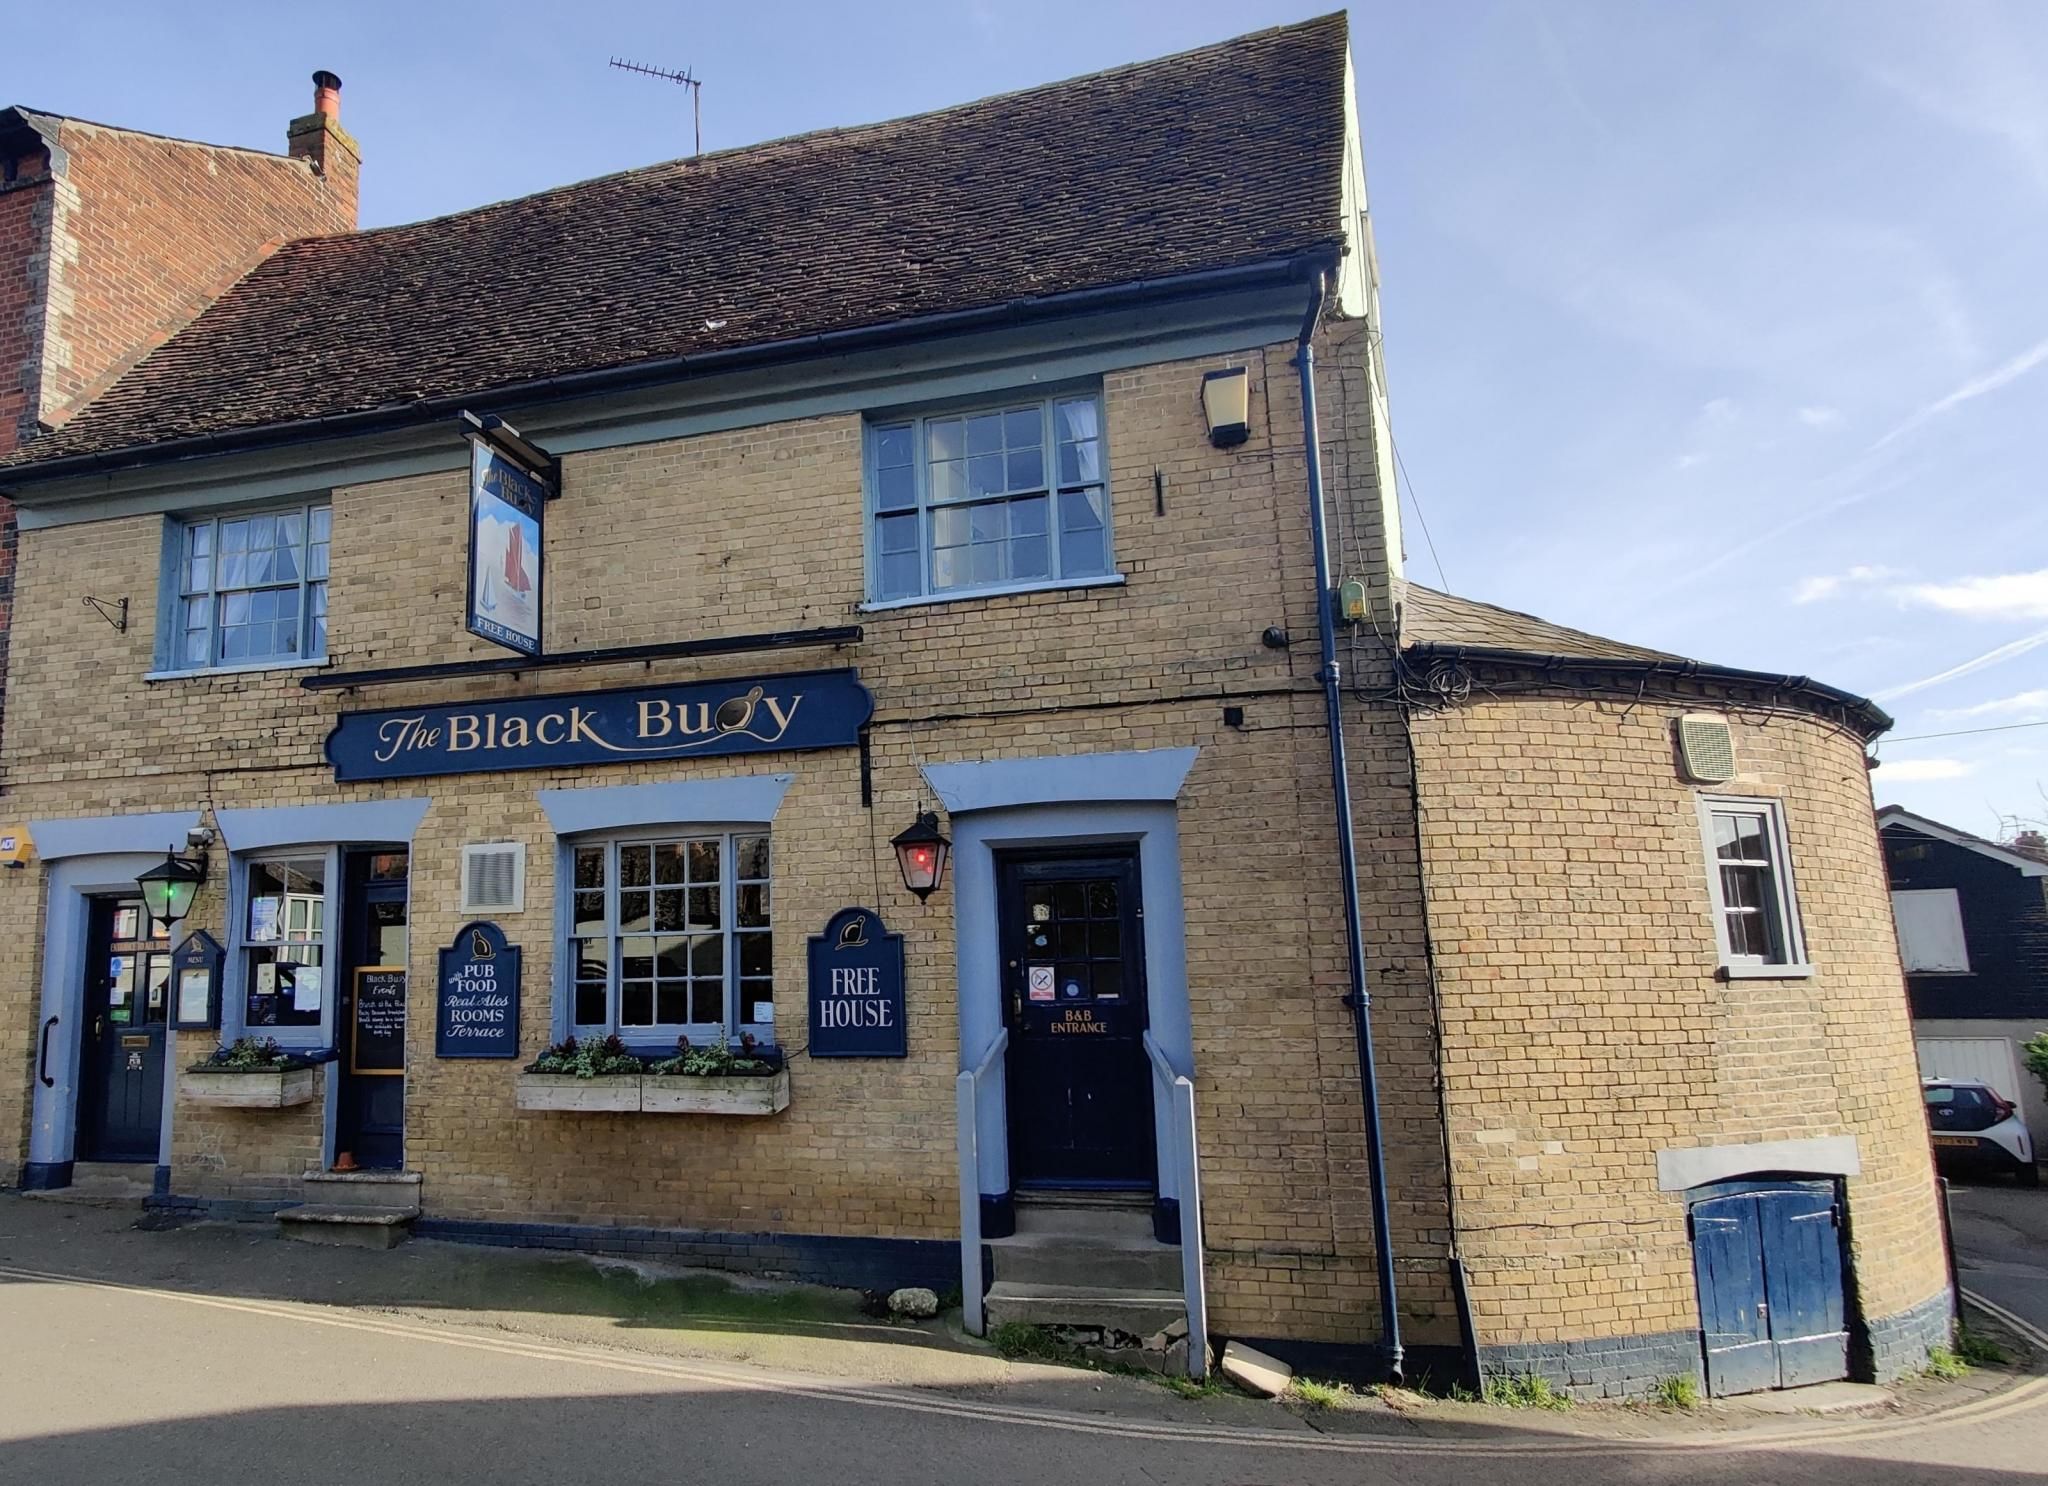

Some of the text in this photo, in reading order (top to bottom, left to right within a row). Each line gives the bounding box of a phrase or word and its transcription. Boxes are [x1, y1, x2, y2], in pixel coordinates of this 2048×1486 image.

[499, 469, 533, 502] Black
[477, 617, 535, 649] FREE HOUSE
[375, 685, 803, 762] The Black Buoy
[464, 964, 494, 977] PUB
[366, 974, 386, 983] Black
[449, 971, 463, 984] with
[831, 967, 881, 996] FREE
[372, 984, 396, 996] Events
[457, 979, 497, 992] FOOD
[445, 994, 509, 1007] Real Ales
[451, 1009, 504, 1022] ROOMS
[820, 999, 893, 1028] HOUSE
[1065, 1009, 1092, 1022] B&B
[446, 1024, 505, 1038] Terrace
[1051, 1022, 1108, 1033] ENTRANCE
